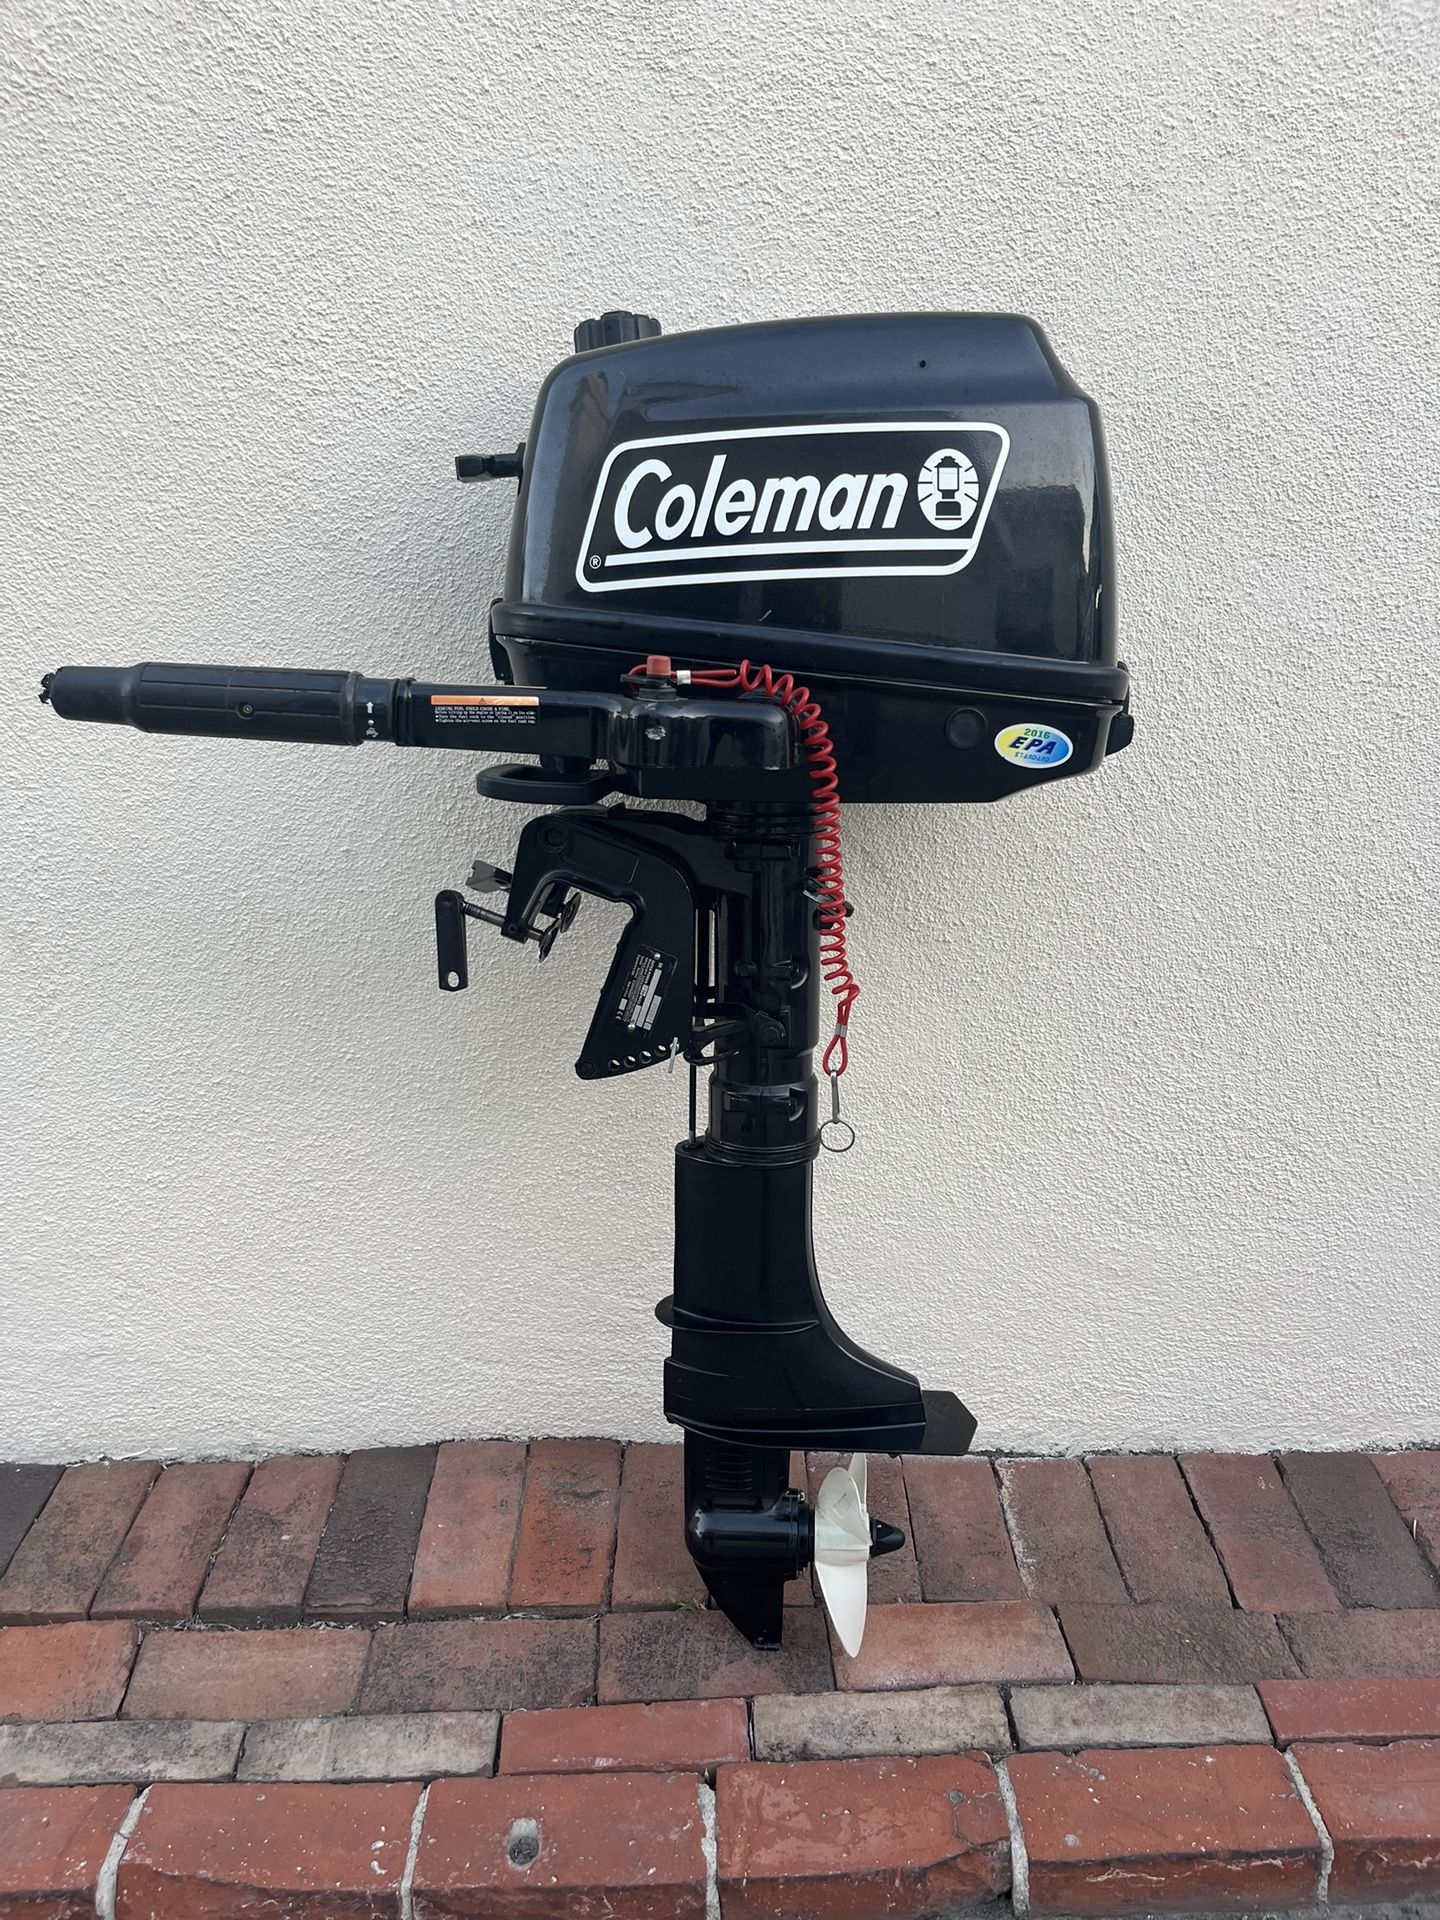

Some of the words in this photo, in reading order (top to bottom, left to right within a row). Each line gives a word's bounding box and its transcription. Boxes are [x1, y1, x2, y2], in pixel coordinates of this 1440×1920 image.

[613, 454, 909, 549] Coleman
[1024, 728, 1050, 740] 2016
[1008, 736, 1057, 755] EPA
